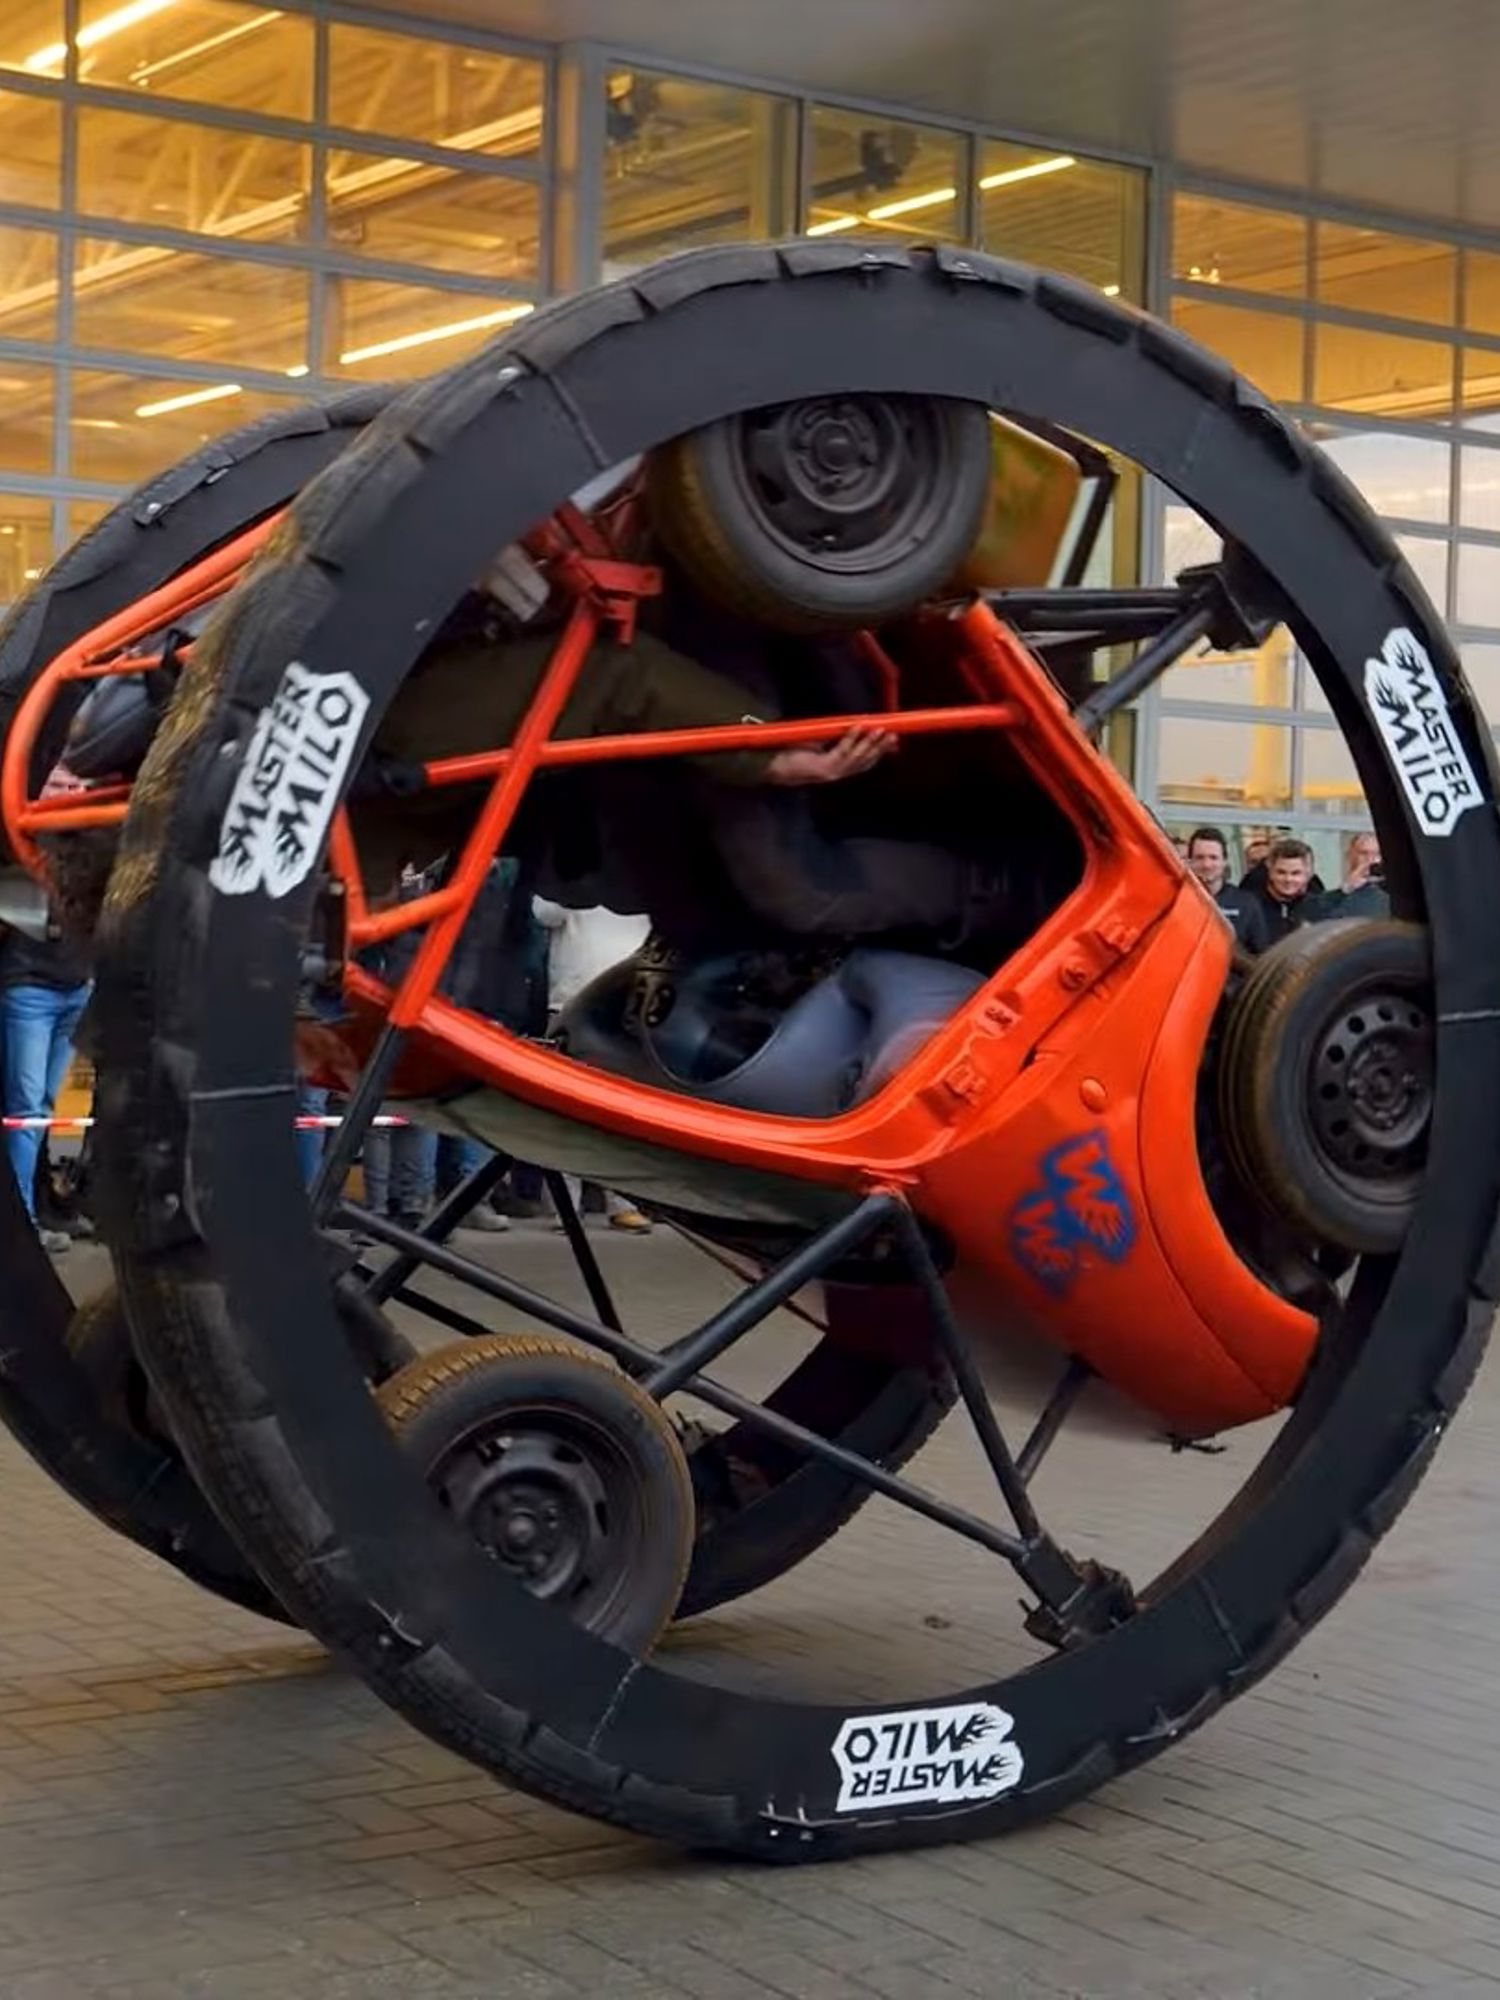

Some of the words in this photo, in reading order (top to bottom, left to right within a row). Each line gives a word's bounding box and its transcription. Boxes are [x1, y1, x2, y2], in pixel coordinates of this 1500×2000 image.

[221, 677, 311, 878] MASTER
[273, 687, 354, 875] MILO
[1374, 671, 1450, 824] MILO
[1396, 638, 1472, 800] MASTER
[844, 1712, 998, 1765] MILO
[850, 1752, 1014, 1798] MASTER
